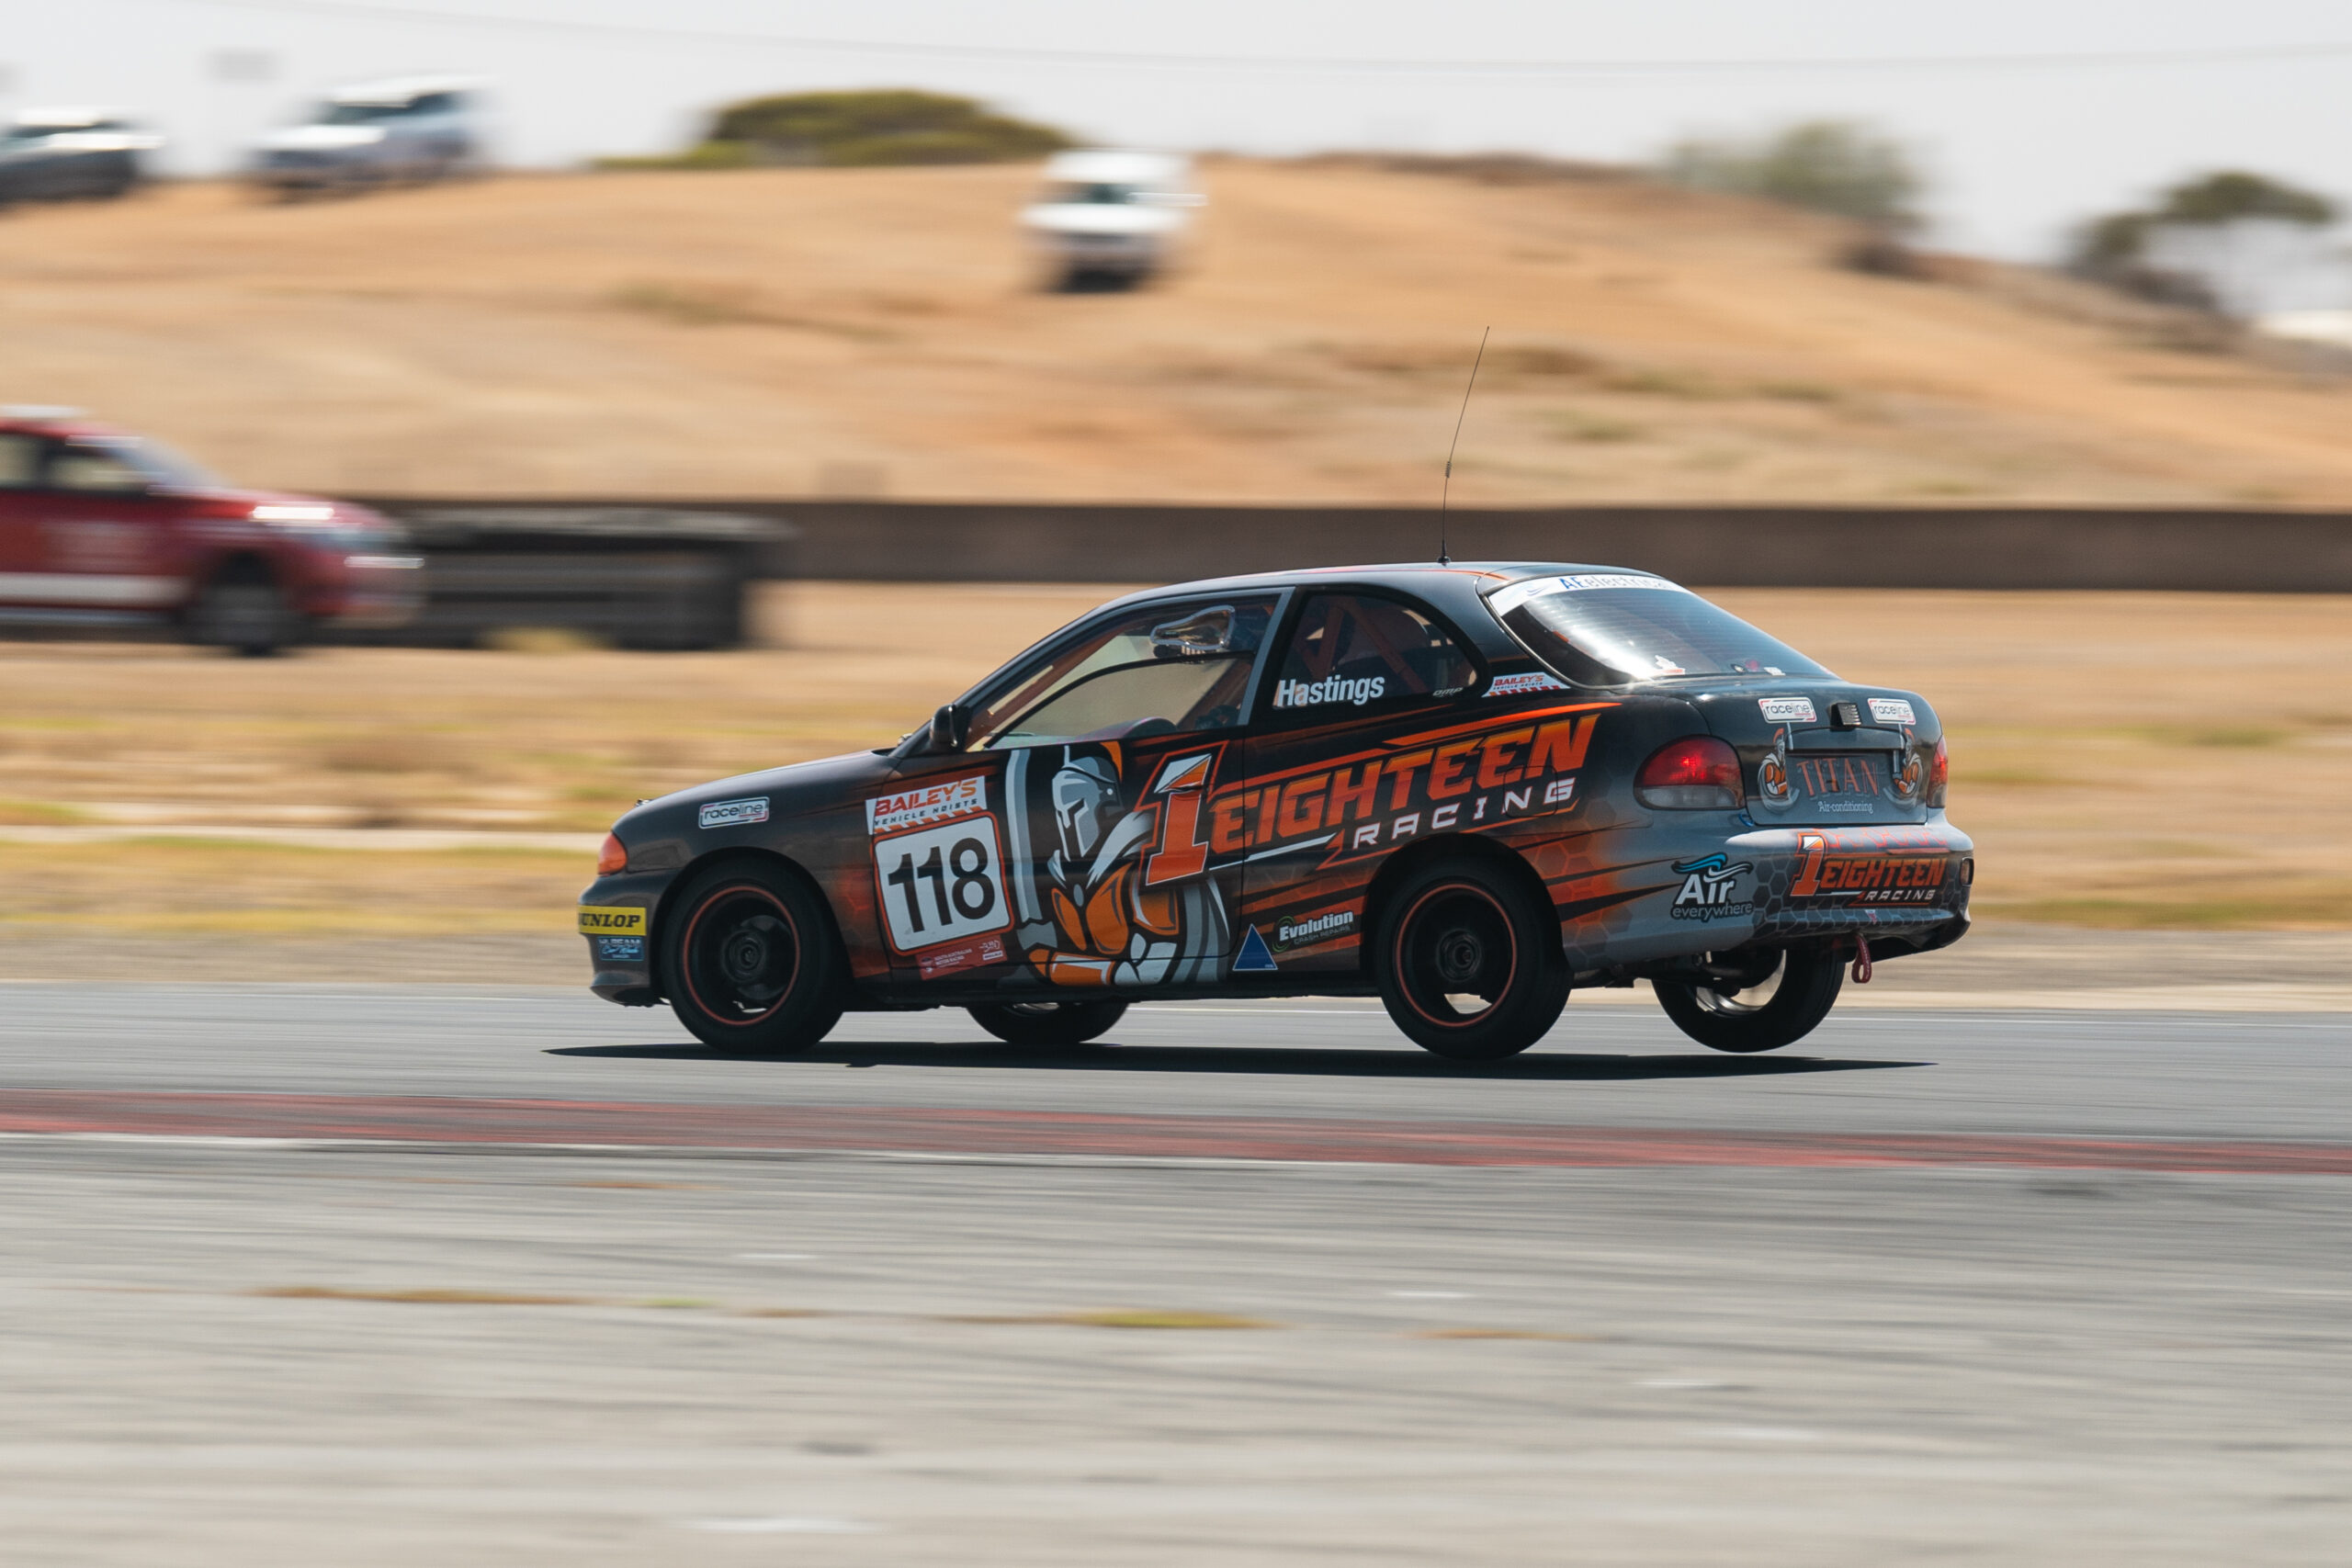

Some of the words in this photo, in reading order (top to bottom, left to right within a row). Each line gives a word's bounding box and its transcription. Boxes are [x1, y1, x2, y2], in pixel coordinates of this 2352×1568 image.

[1276, 674, 1385, 706] Hastings
[1495, 674, 1544, 686] BAILEY'S
[1766, 701, 1811, 714] raceline
[1874, 704, 1911, 716] raceline
[1209, 713, 1601, 854] EIGHTEEN
[1797, 758, 1879, 796] TITAN
[704, 804, 763, 819] raceline
[875, 810, 925, 826] VEHICLE
[933, 798, 978, 814] HOISTS
[876, 780, 978, 817] BAILEY'S
[1352, 777, 1577, 850] RACING
[1818, 801, 1873, 814] Air-conditioning
[888, 837, 995, 933] 118
[1820, 857, 1948, 888] EIGHTEEN
[1675, 874, 1736, 905] Air
[1864, 889, 1936, 901] RACING
[1279, 911, 1353, 942] Evolution
[1672, 903, 1753, 920] everywhere
